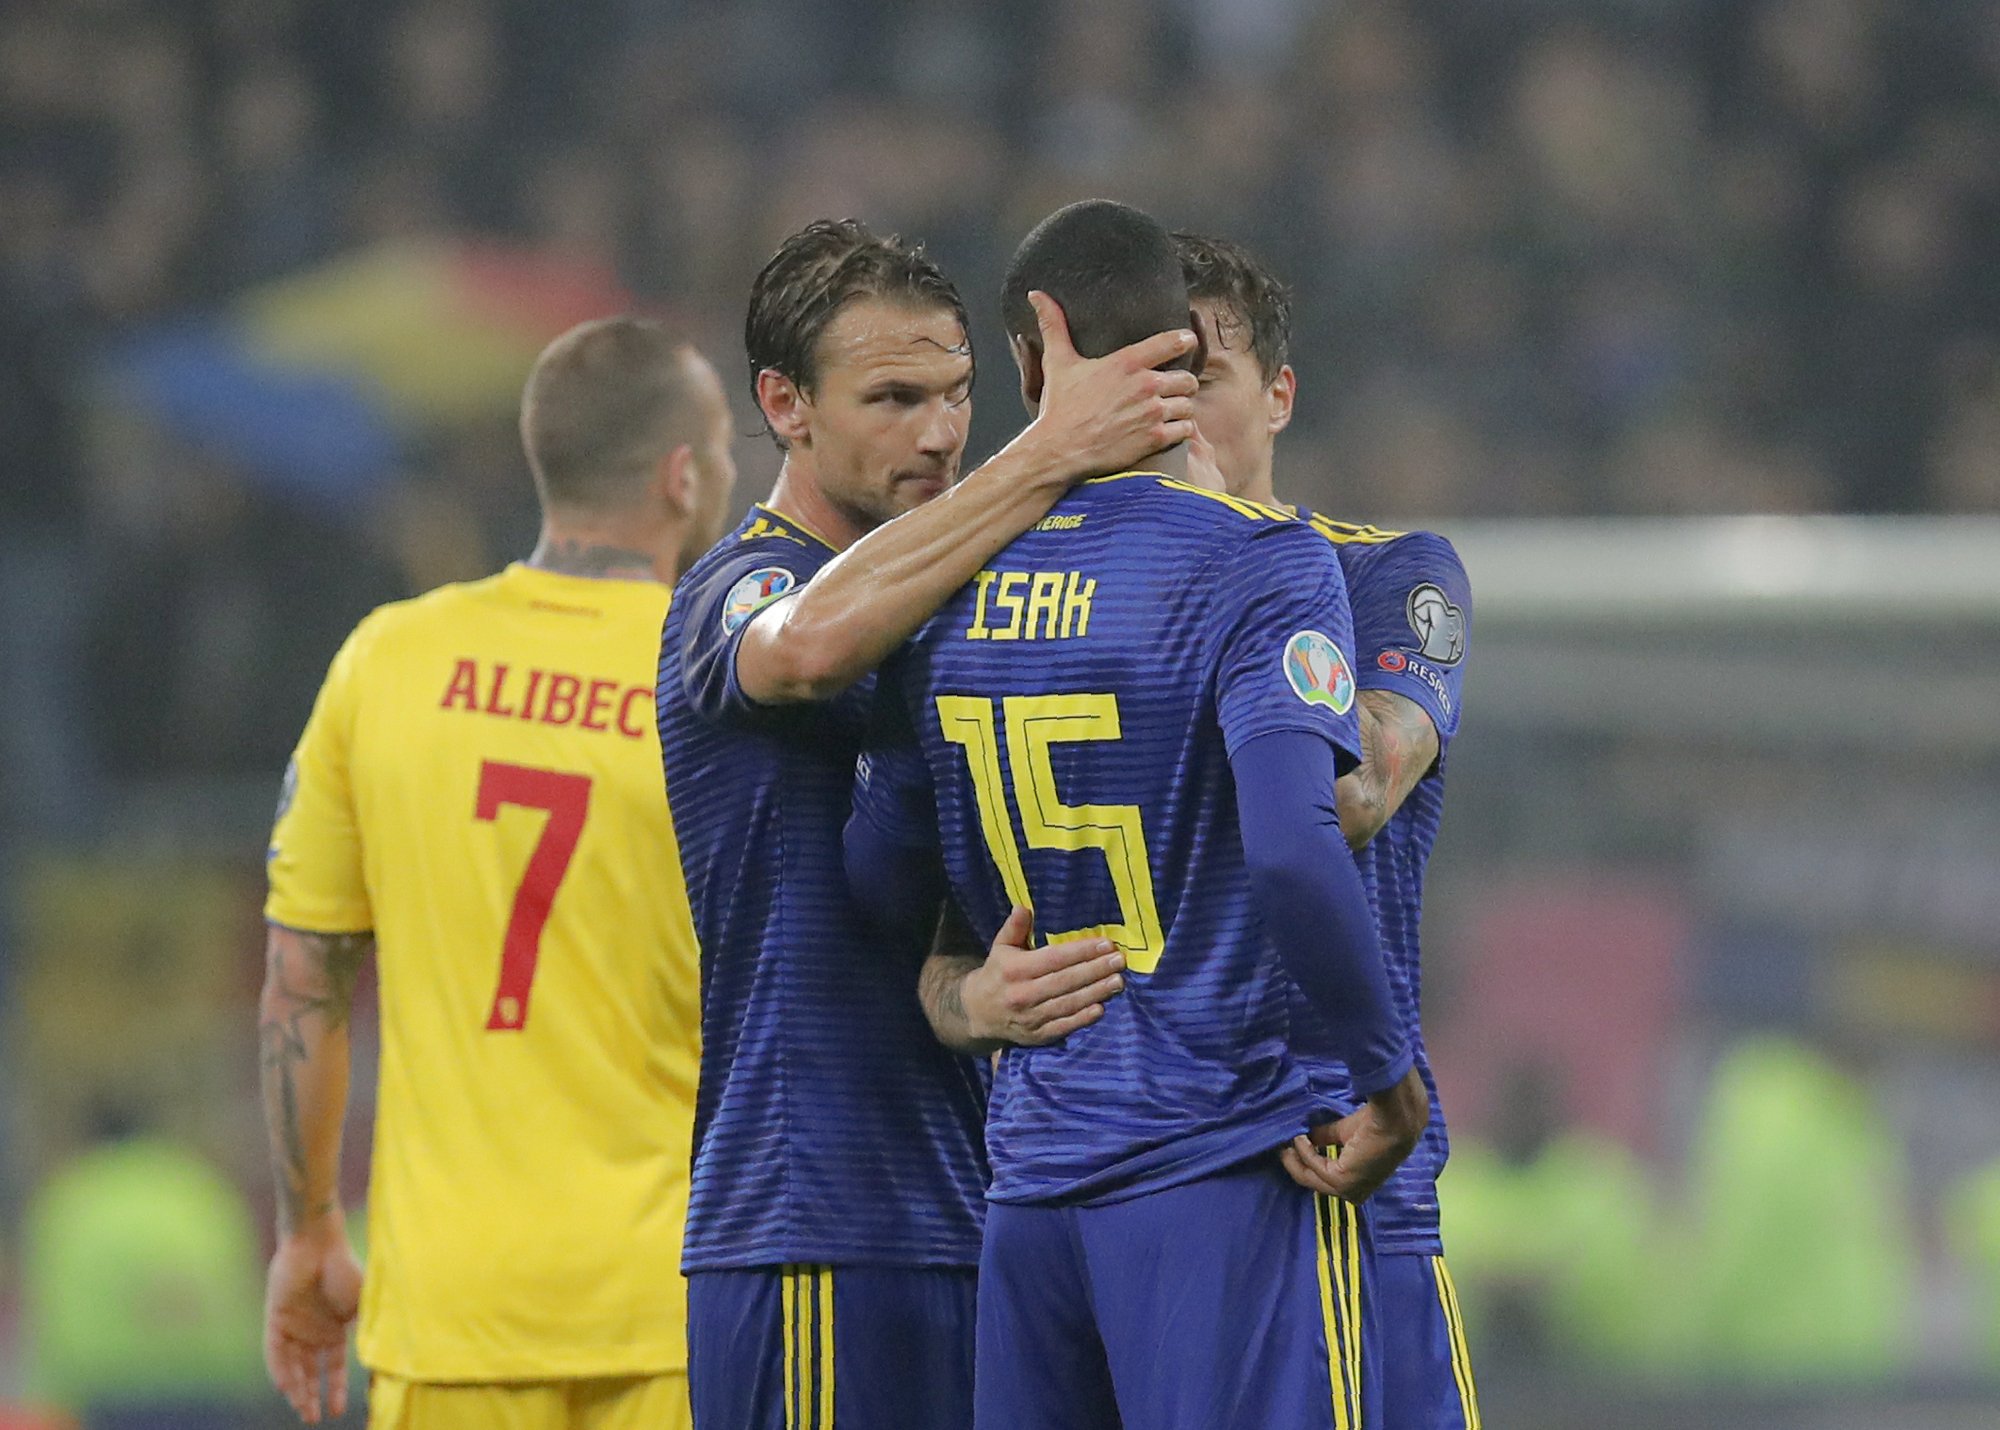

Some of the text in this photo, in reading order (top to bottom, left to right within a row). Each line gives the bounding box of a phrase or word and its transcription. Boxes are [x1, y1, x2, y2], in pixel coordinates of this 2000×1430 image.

[966, 571, 1096, 640] ISAK
[441, 660, 654, 739] ALIBEC
[473, 760, 592, 1030] 7
[936, 693, 1165, 974] 15
